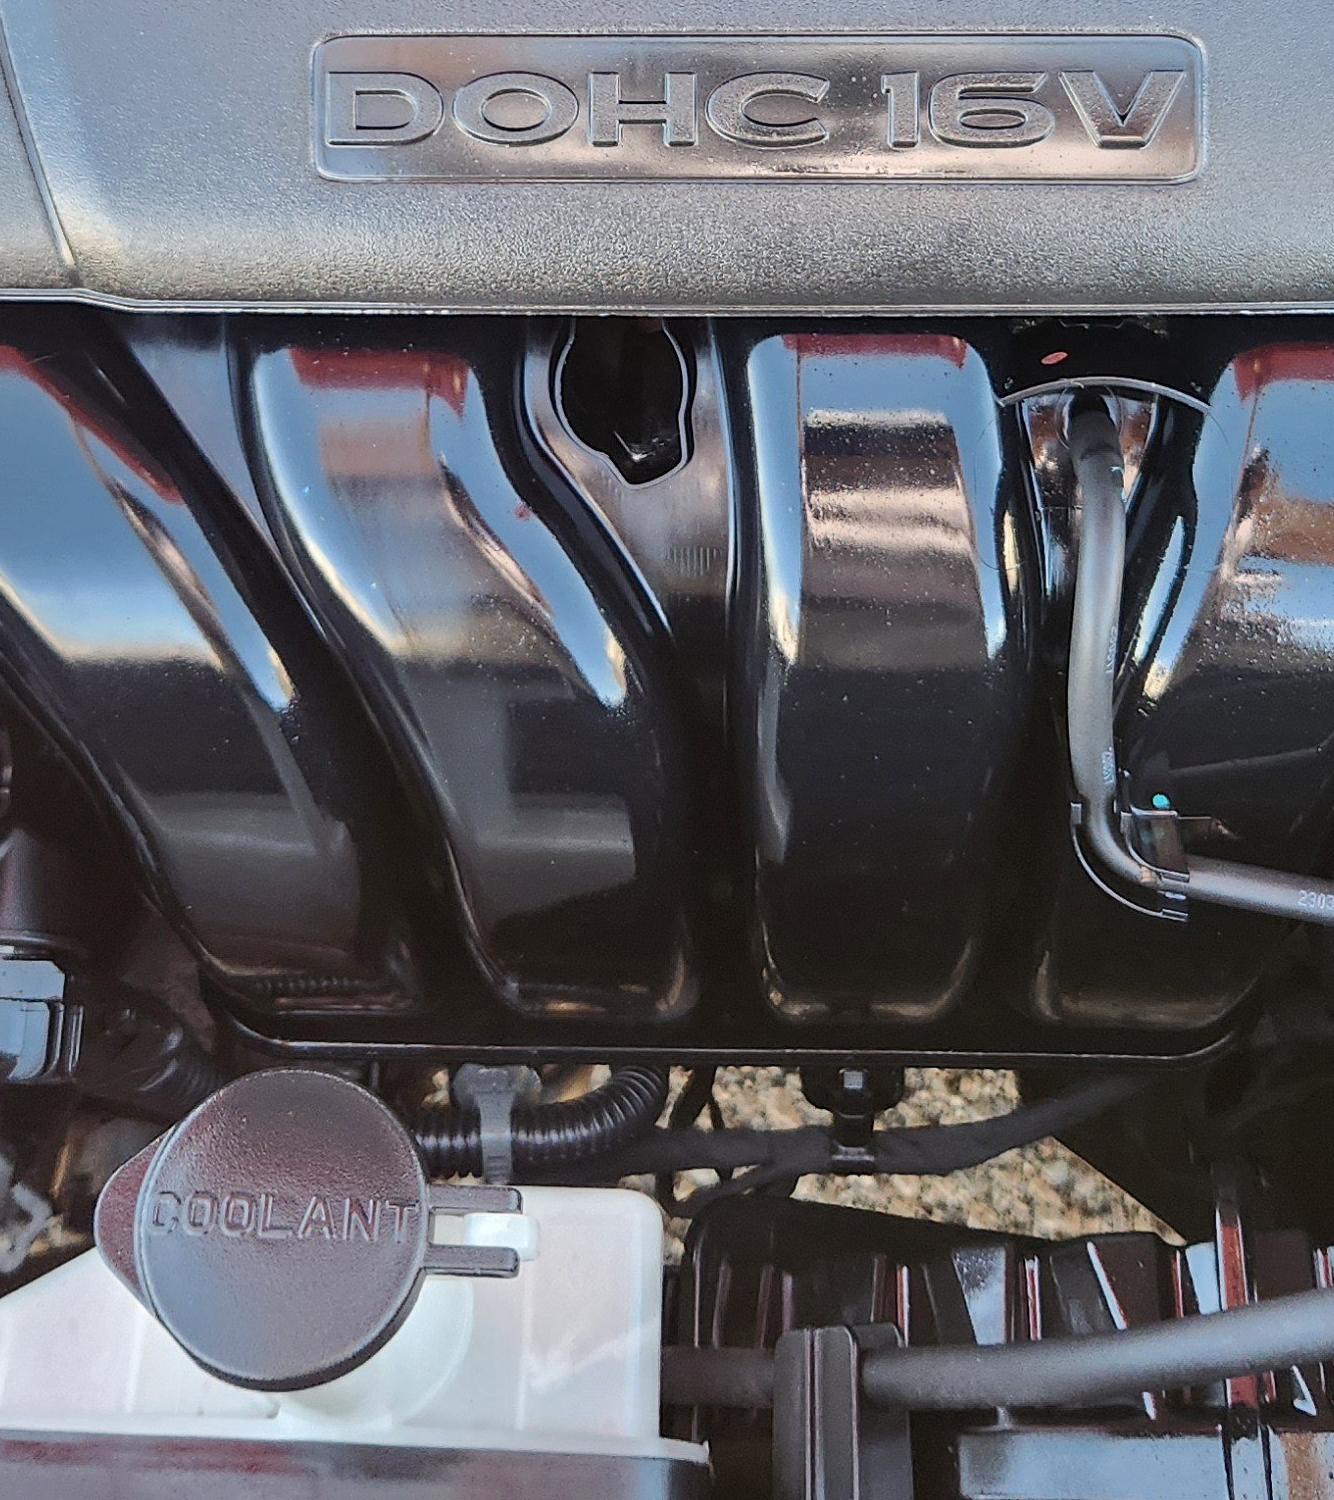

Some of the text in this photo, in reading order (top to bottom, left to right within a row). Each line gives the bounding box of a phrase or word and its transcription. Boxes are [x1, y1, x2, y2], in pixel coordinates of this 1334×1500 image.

[324, 70, 1187, 150] DOHC 16V
[147, 1190, 419, 1244] COOLANT
